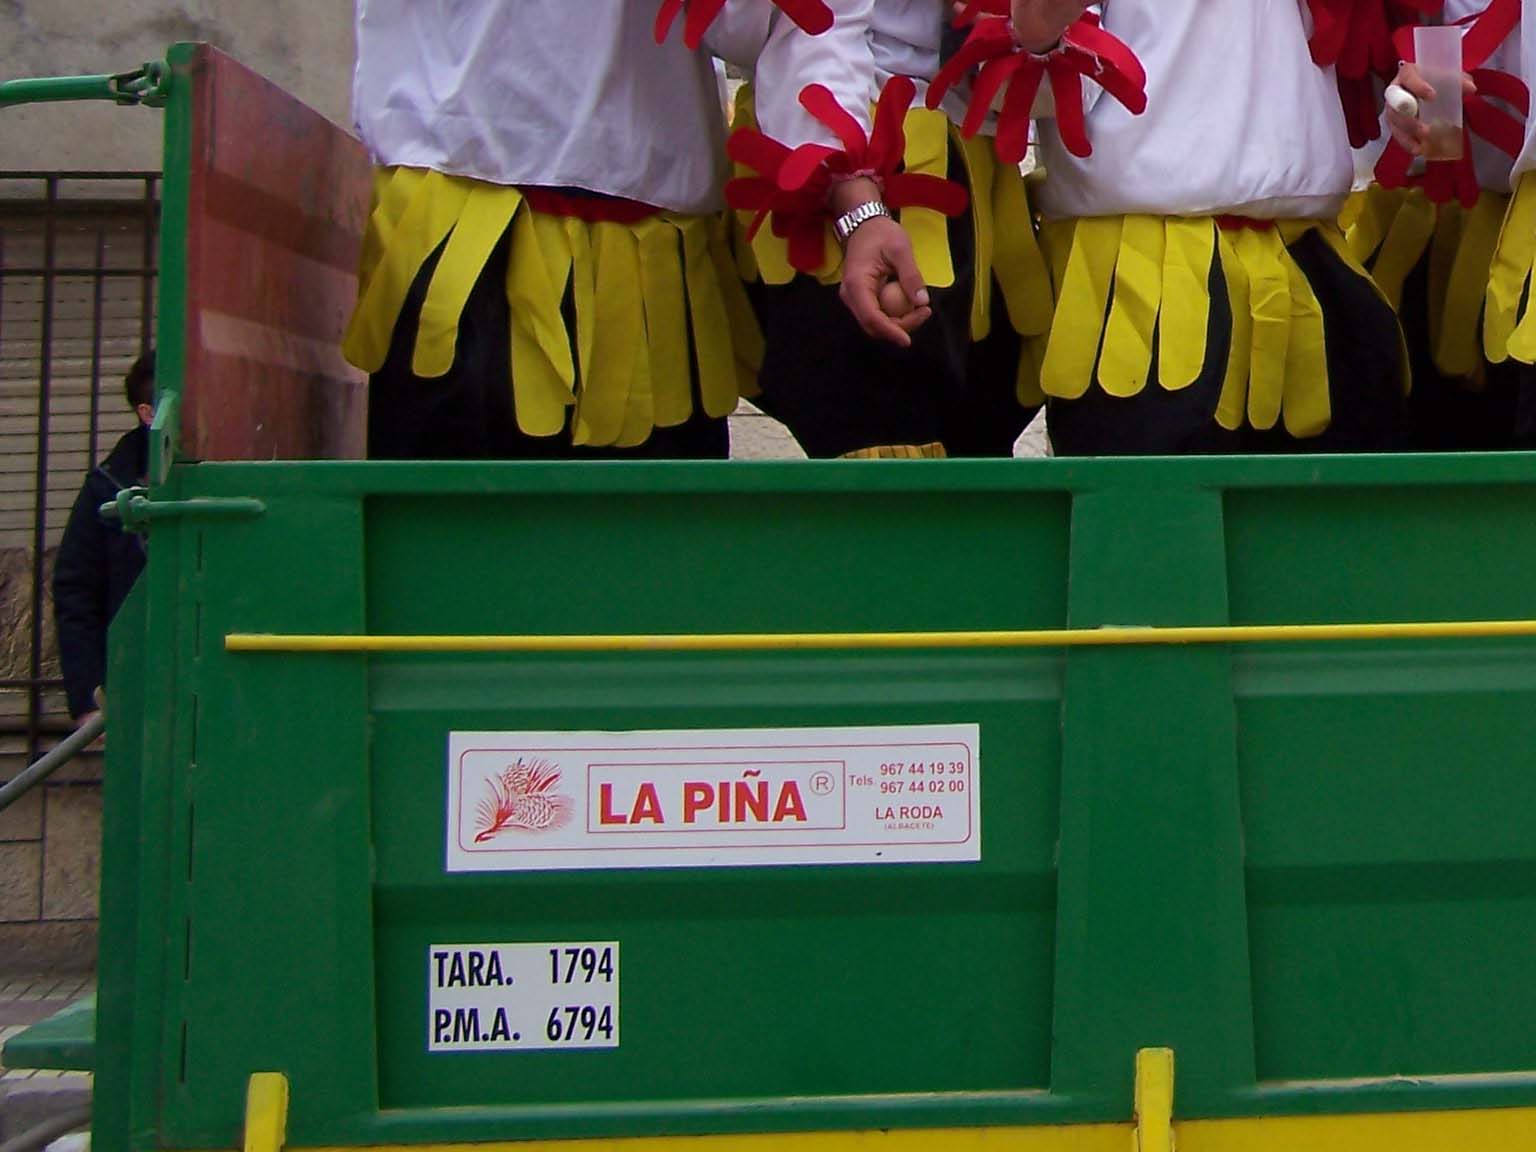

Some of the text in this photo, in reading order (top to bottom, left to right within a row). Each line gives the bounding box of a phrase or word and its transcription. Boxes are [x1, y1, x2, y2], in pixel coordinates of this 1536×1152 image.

[880, 761, 965, 776] 967 44 19 39
[600, 783, 665, 825] LA
[683, 769, 808, 824] PIÑA
[880, 779, 965, 794] 967 44 02 00
[875, 805, 944, 820] LA RODA
[434, 947, 614, 988] TARA. 1794
[433, 1005, 614, 1043] P.M.A. 6794
